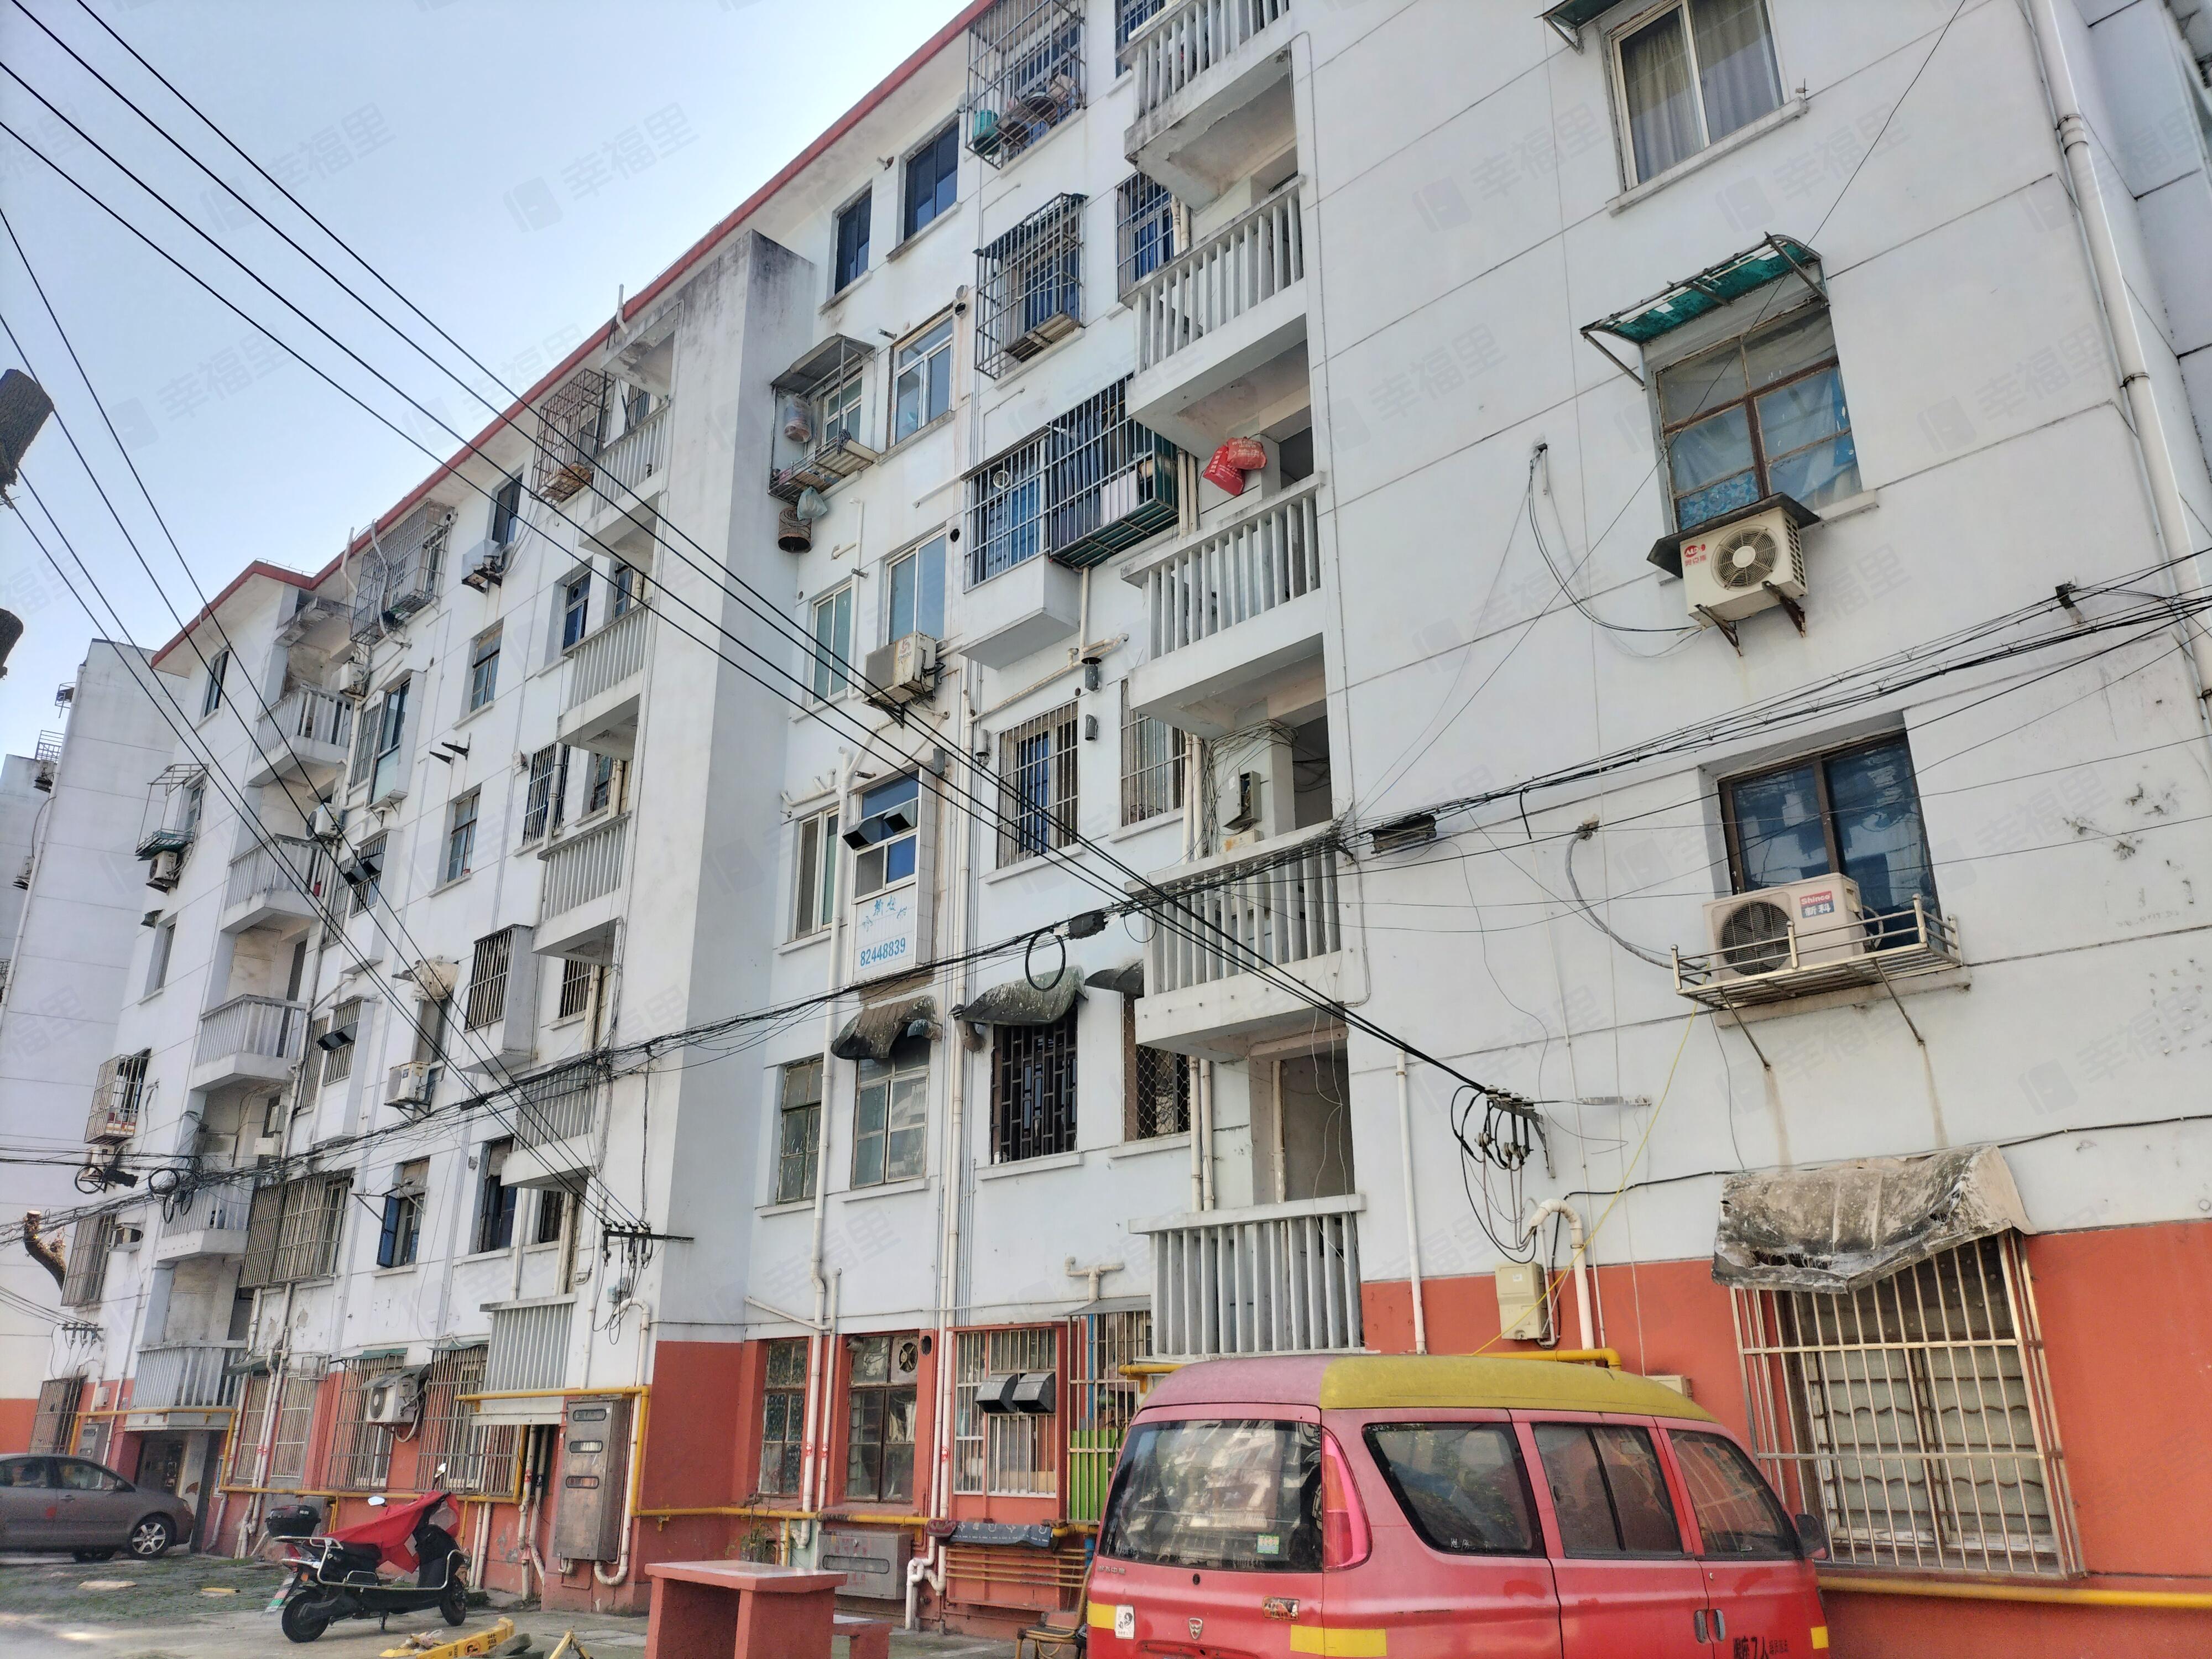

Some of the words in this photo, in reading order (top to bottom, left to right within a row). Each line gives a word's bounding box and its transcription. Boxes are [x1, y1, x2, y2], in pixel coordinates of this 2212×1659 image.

[1801, 894, 1830, 905] Shinco
[1804, 903, 1832, 916] 新科
[860, 937, 906, 967] 82448839
